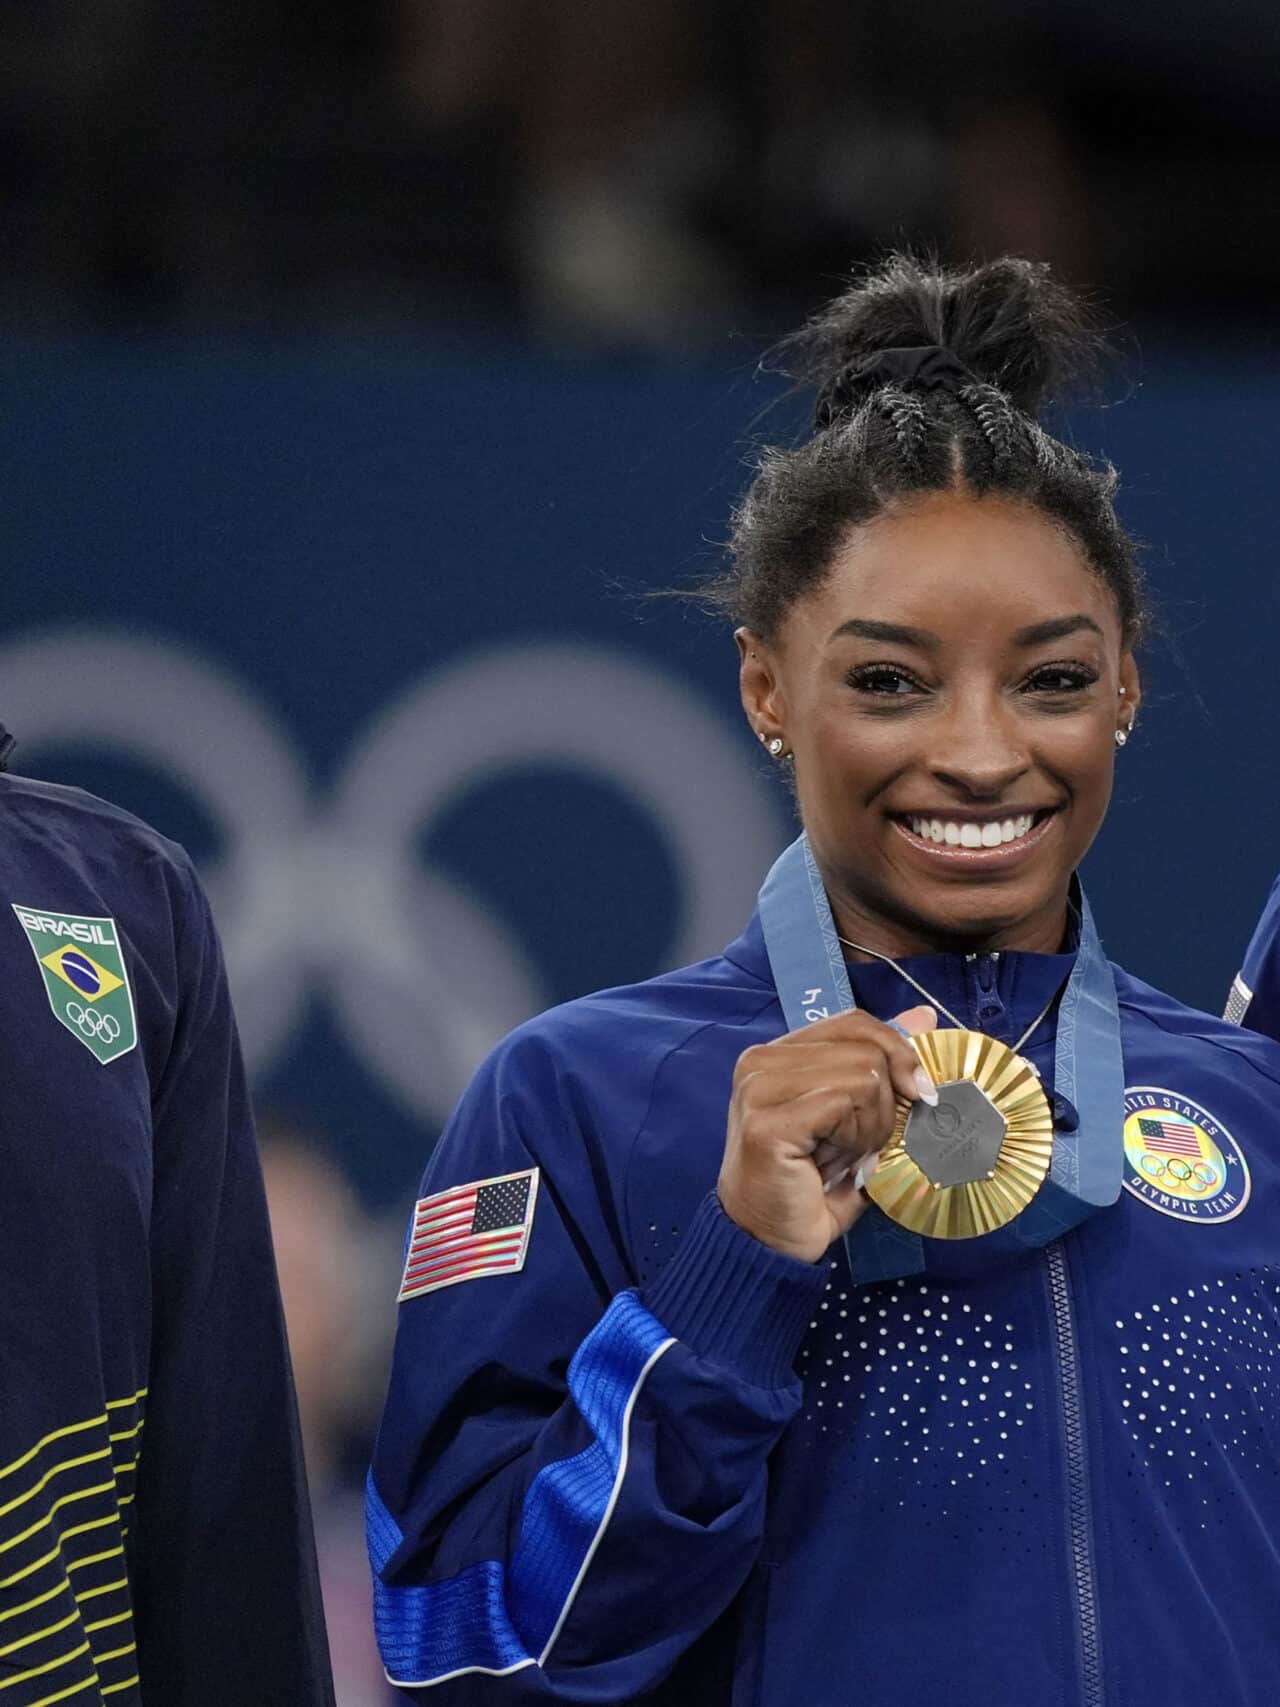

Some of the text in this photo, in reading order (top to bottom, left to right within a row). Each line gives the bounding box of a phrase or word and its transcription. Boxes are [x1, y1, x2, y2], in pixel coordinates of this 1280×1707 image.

[17, 912, 115, 945] BRASIL
[1124, 1095, 1218, 1136] ITED STATES
[1131, 1177, 1236, 1214] OLYMPIC TEAM
